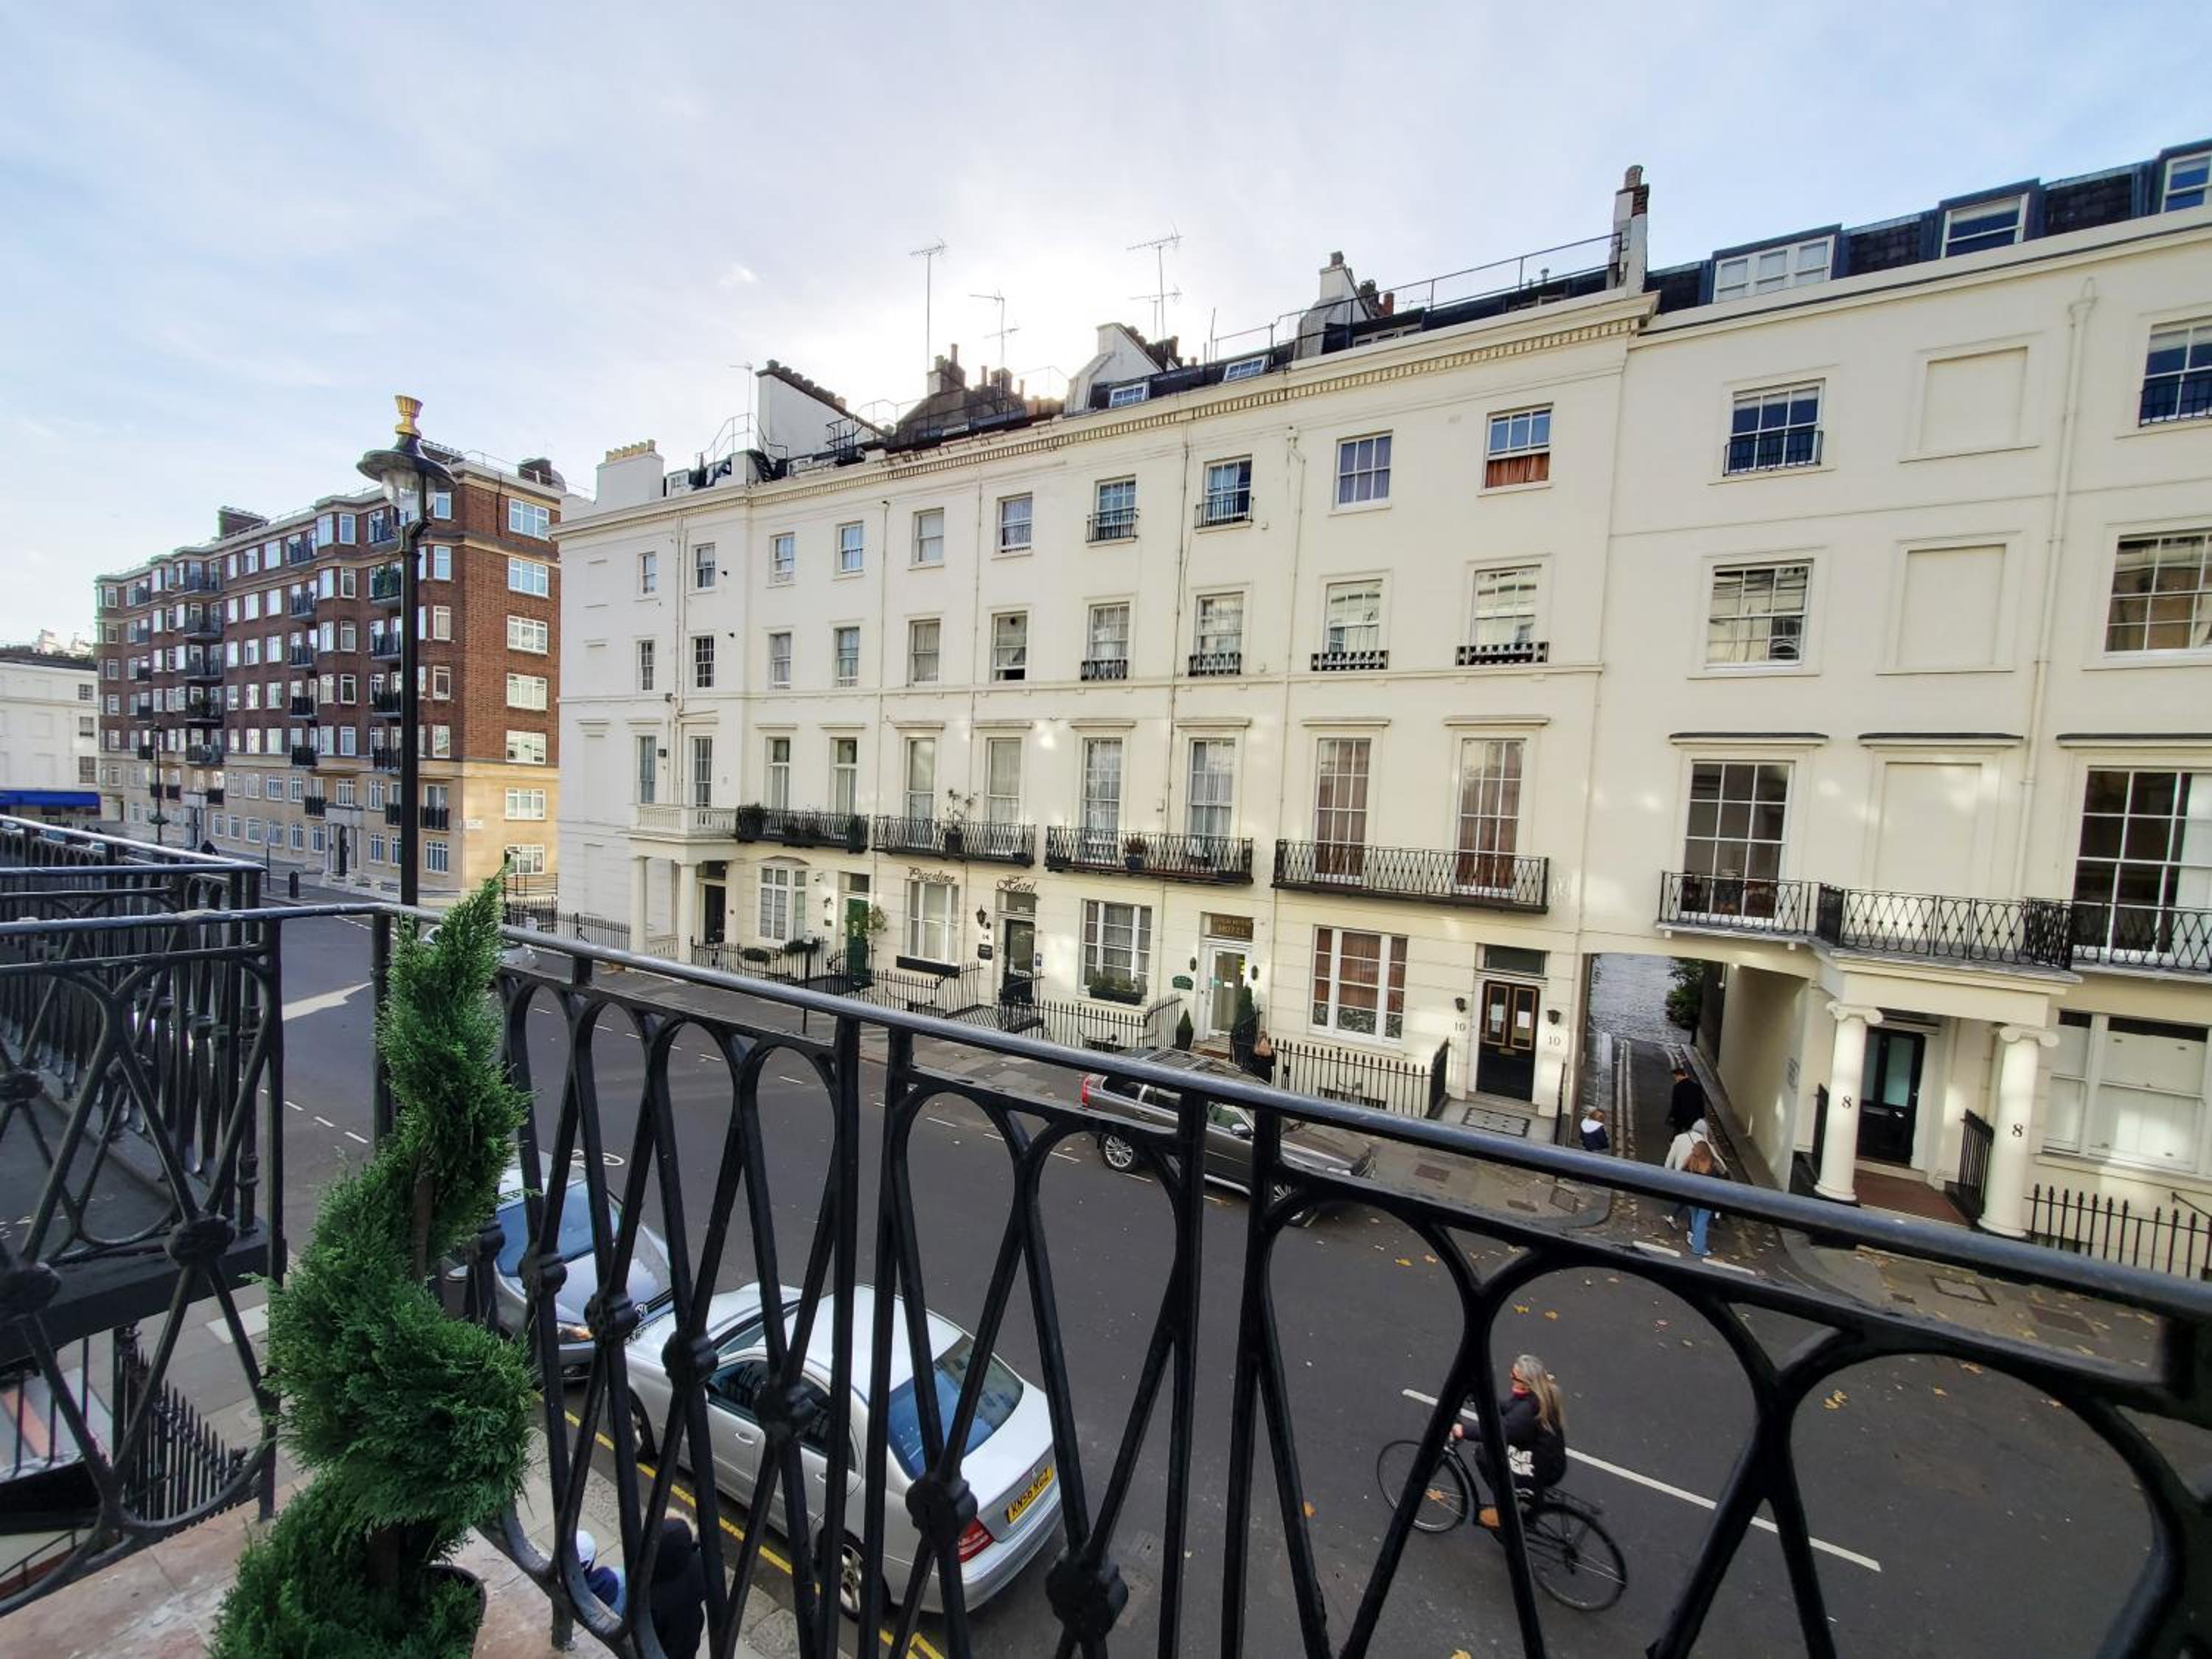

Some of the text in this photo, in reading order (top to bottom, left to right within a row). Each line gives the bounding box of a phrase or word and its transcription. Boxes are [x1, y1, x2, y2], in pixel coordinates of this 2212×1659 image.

[996, 875, 1037, 891] Hotel
[1455, 1021, 1467, 1032] 10
[1548, 1035, 1561, 1046] 10
[1842, 1096, 1851, 1109] 8
[2012, 1124, 2023, 1138] 8
